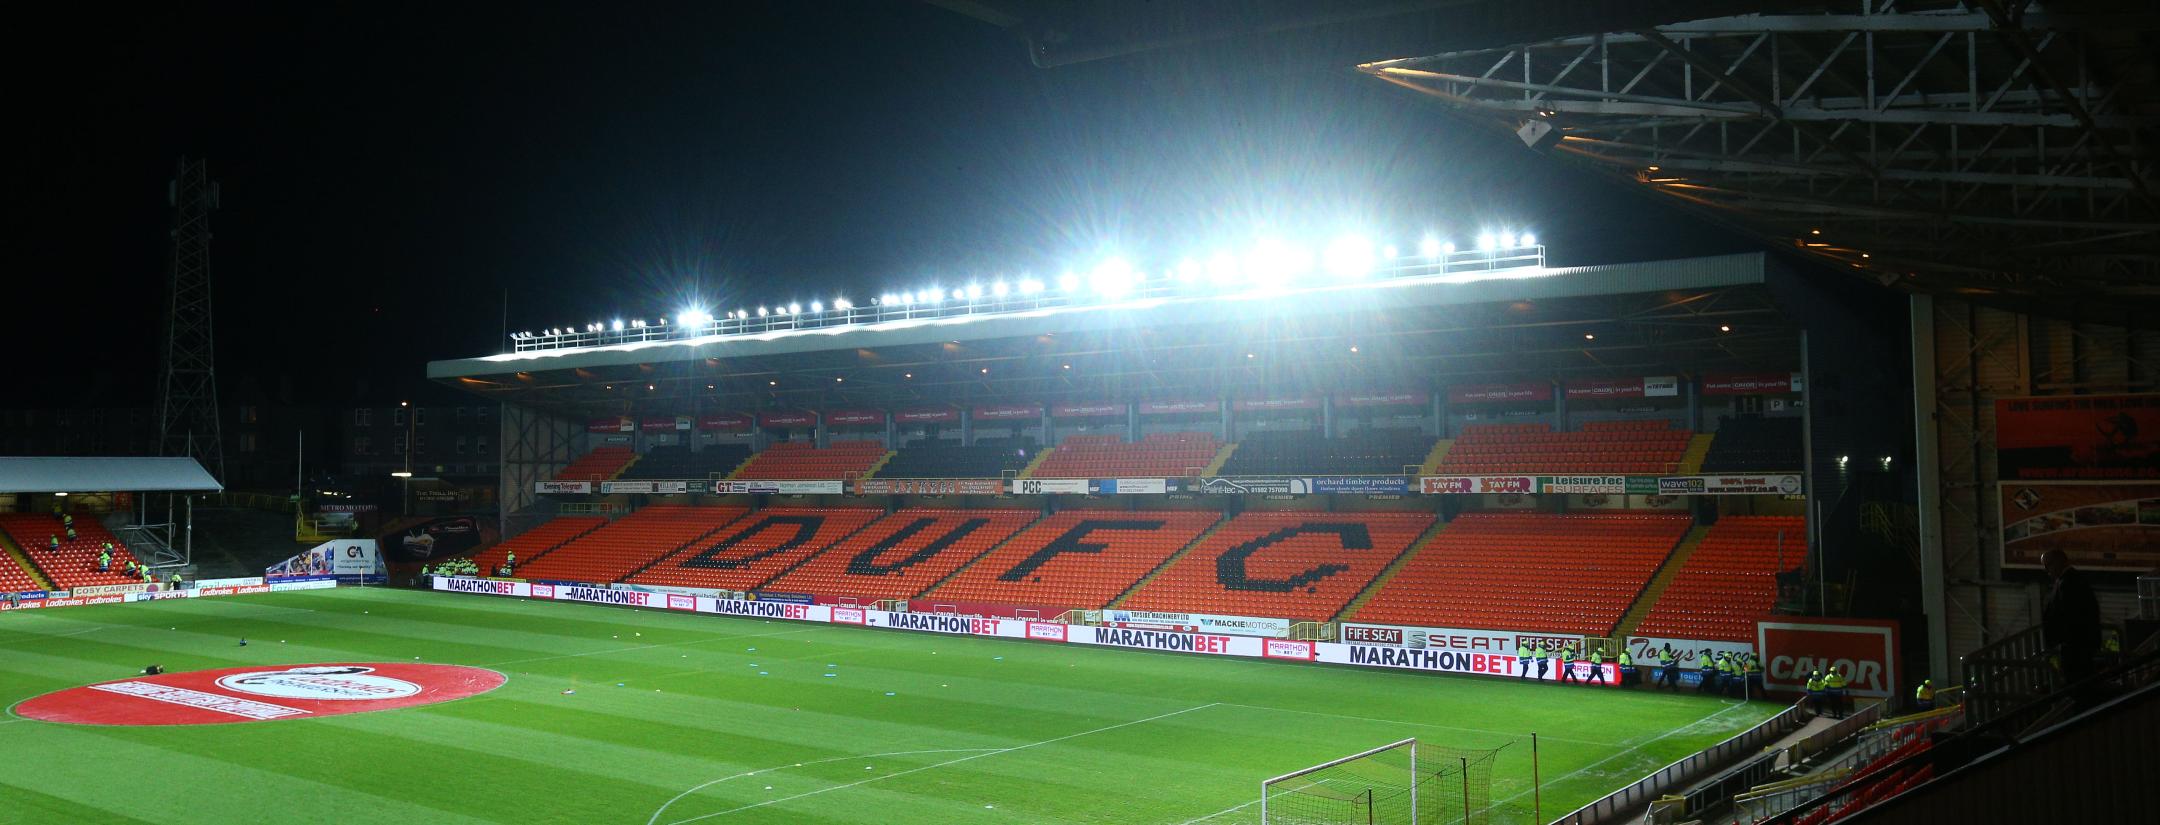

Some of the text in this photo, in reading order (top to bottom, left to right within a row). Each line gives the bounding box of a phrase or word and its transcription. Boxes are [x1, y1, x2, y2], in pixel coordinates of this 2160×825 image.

[1593, 386, 1613, 394] CALOR
[1734, 381, 1755, 389] CALOR
[1316, 477, 1405, 487] orchard timber products
[1450, 481, 1463, 489] FM
[1555, 477, 1623, 485] LeisureTec
[1661, 479, 1703, 488] wave102
[1022, 481, 1042, 494] PCC
[76, 587, 102, 595] COSY
[103, 584, 145, 593] CARPETS
[237, 586, 270, 594] Ladbrokes
[447, 579, 516, 595] MARATHONBET
[138, 591, 187, 601] sky SPORTS
[200, 588, 233, 597] Ladbrokes
[571, 587, 651, 606] MARATHONBET
[1, 601, 41, 610] Larokes
[45, 599, 84, 608] Ladbrokes
[86, 596, 122, 605] Ladbrokes
[715, 599, 810, 620] MARATHONBET
[1152, 612, 1180, 620] MACHINERY
[888, 613, 1000, 635] MARATHONBET
[1031, 625, 1062, 633] MARATHON
[1095, 627, 1231, 653] MARATHONBET
[1347, 627, 1400, 643] FIFE SEAT
[1269, 642, 1308, 652] MARATHON
[1428, 634, 1511, 651] SEAT
[1350, 645, 1518, 675] MARATHONBET
[1770, 655, 1884, 692] CALOR
